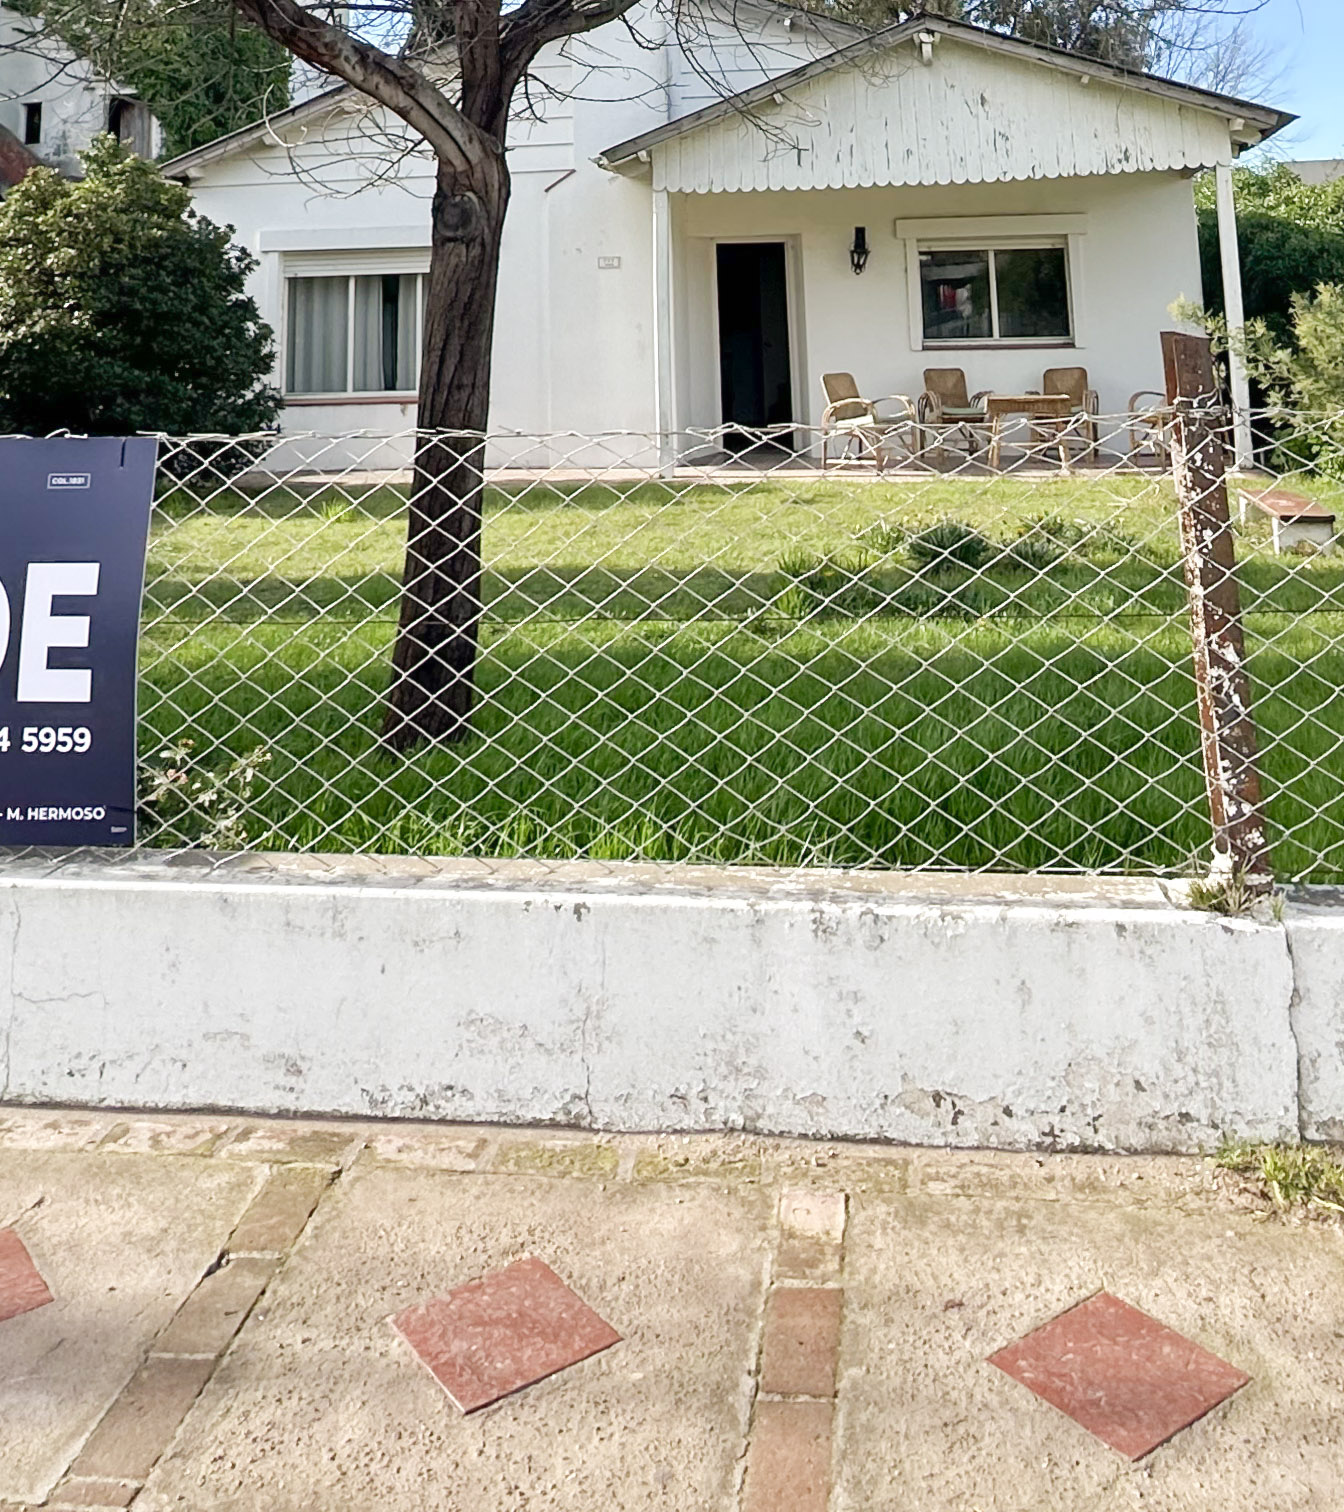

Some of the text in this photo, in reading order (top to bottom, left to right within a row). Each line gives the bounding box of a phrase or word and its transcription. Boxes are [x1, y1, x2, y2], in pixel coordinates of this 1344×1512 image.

[21, 726, 92, 753] 5959
[6, 806, 24, 820] M.
[27, 806, 105, 821] HERMOSO
